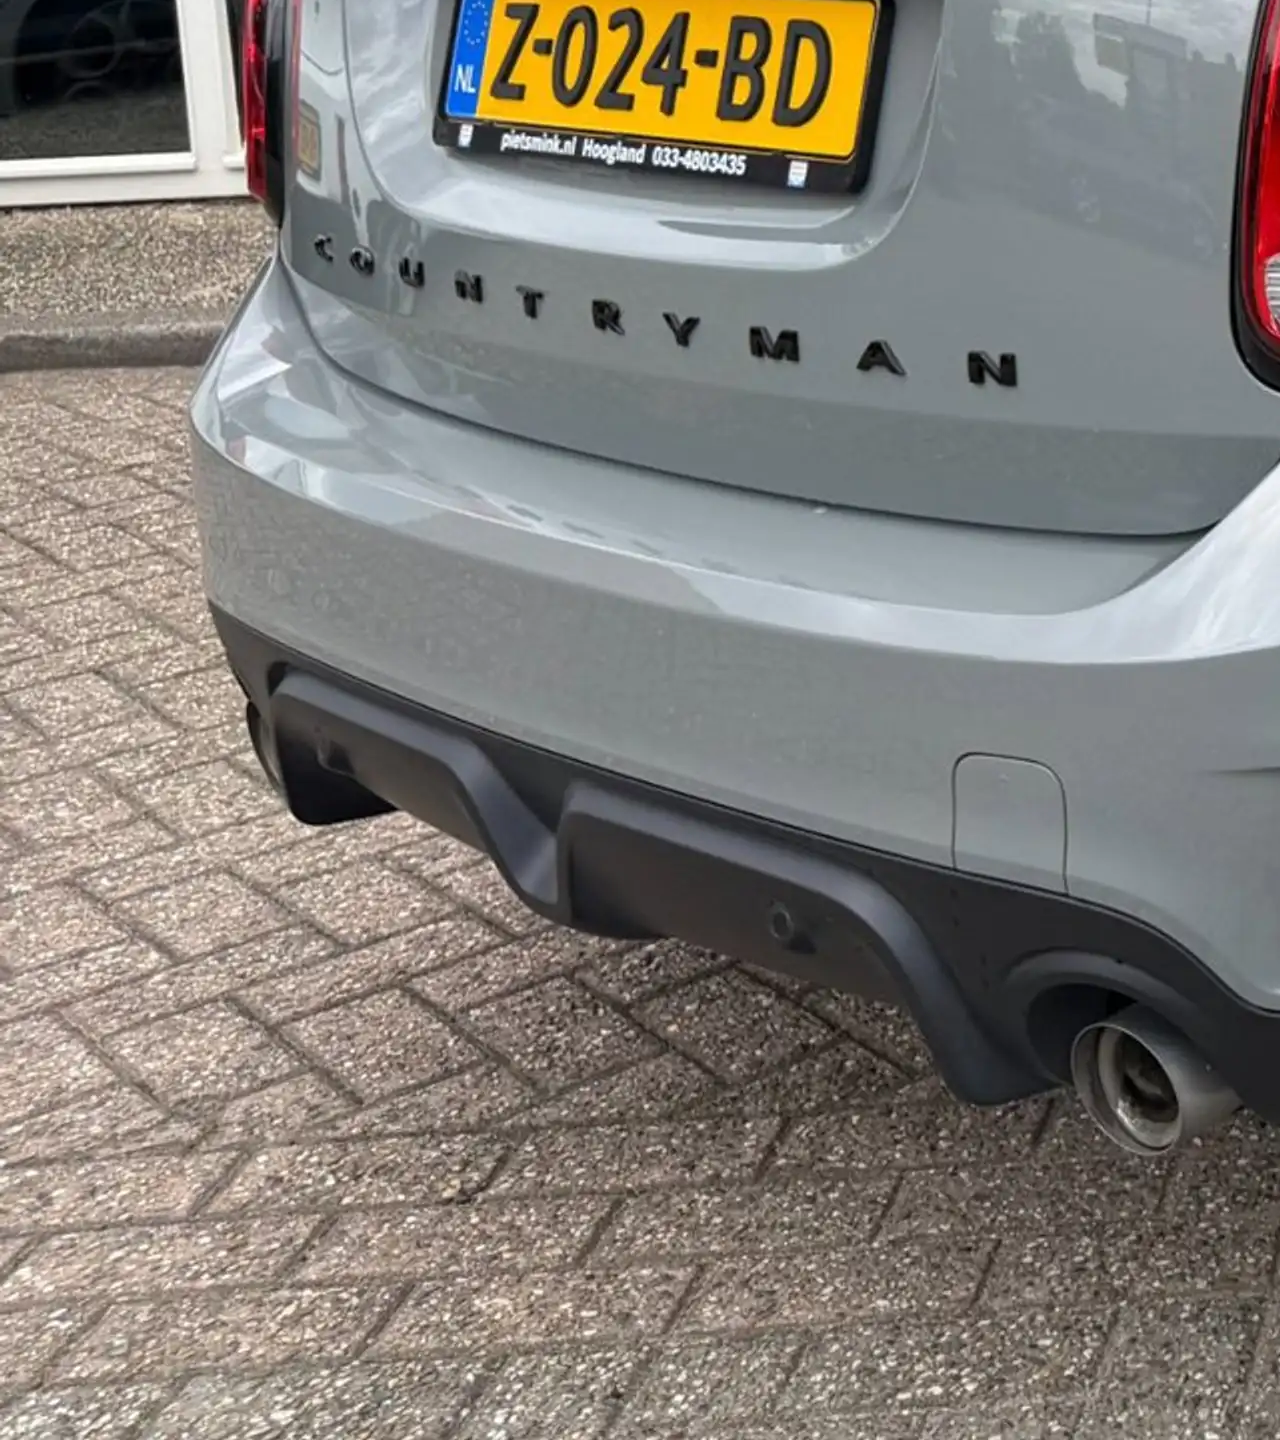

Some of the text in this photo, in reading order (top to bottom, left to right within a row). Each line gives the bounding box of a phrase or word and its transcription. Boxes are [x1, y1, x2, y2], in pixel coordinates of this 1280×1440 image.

[454, 63, 477, 95] NL
[490, 2, 833, 128] Z-024-BD
[500, 129, 748, 176] pietsmink.nl Hoogland 033-4803435
[313, 234, 1019, 388] COUNTRYMAN
